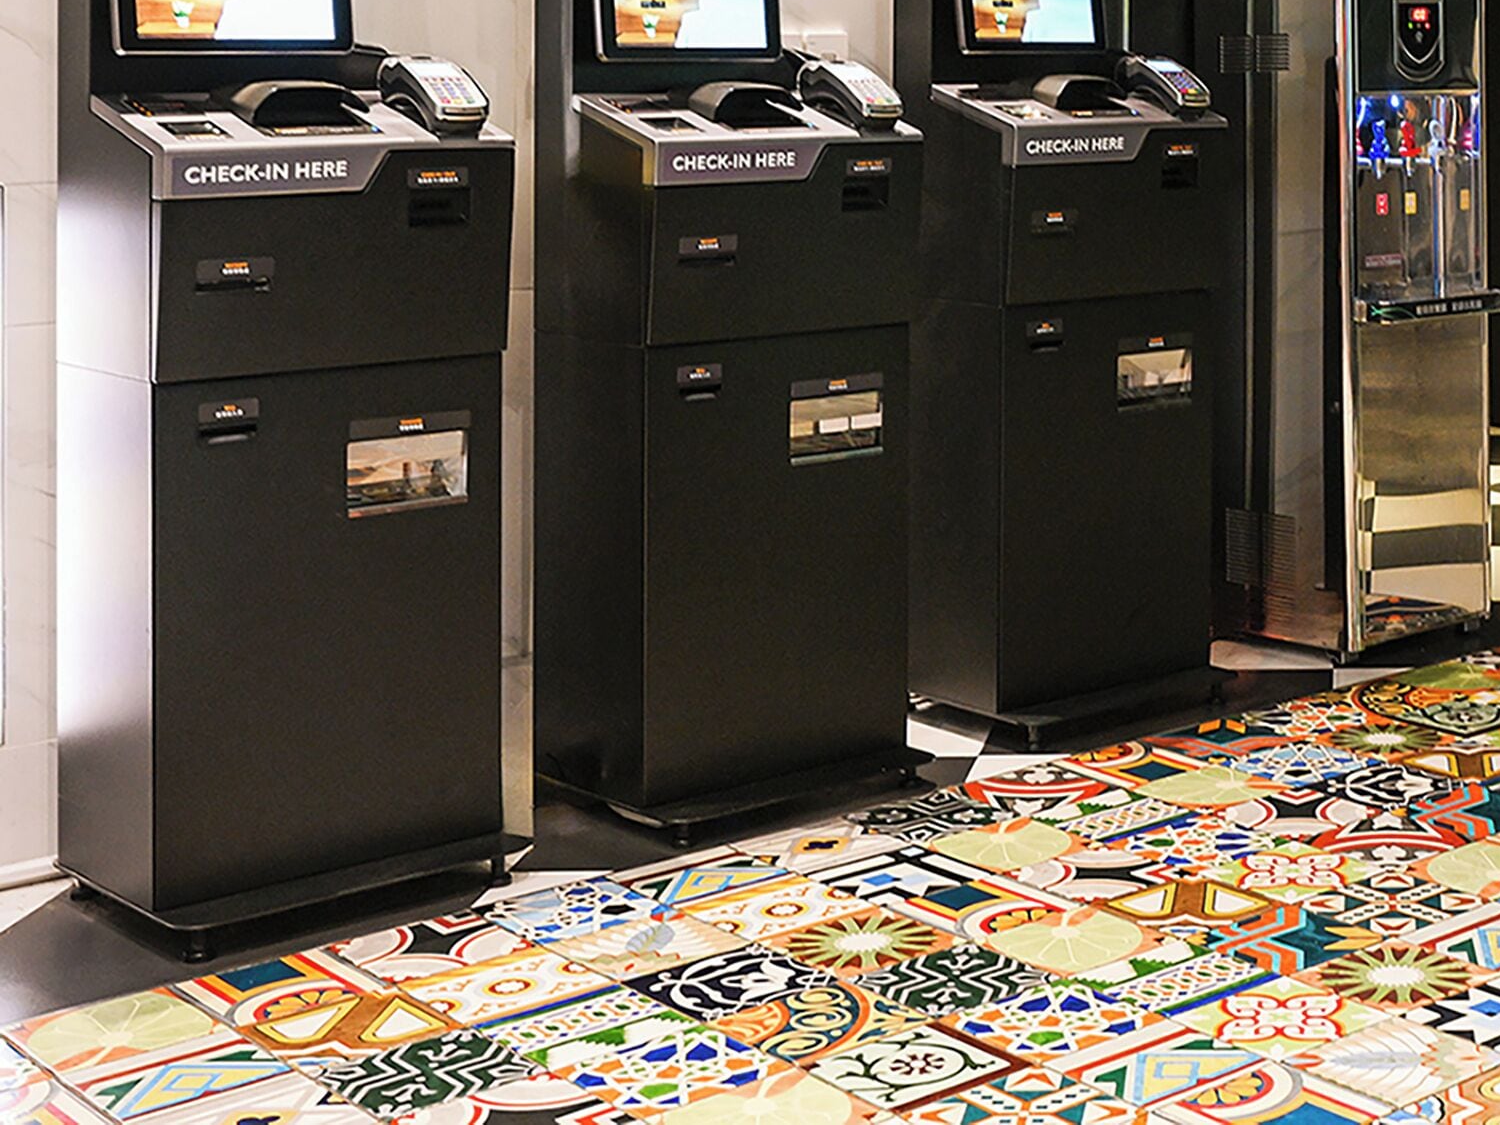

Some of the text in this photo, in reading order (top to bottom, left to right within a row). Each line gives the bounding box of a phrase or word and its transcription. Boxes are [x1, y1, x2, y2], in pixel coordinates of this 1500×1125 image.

[1026, 136, 1125, 155] CHECK-IN HERE
[184, 159, 348, 185] CHECK-IN HERE
[672, 151, 796, 172] CHECK-IN HERE
